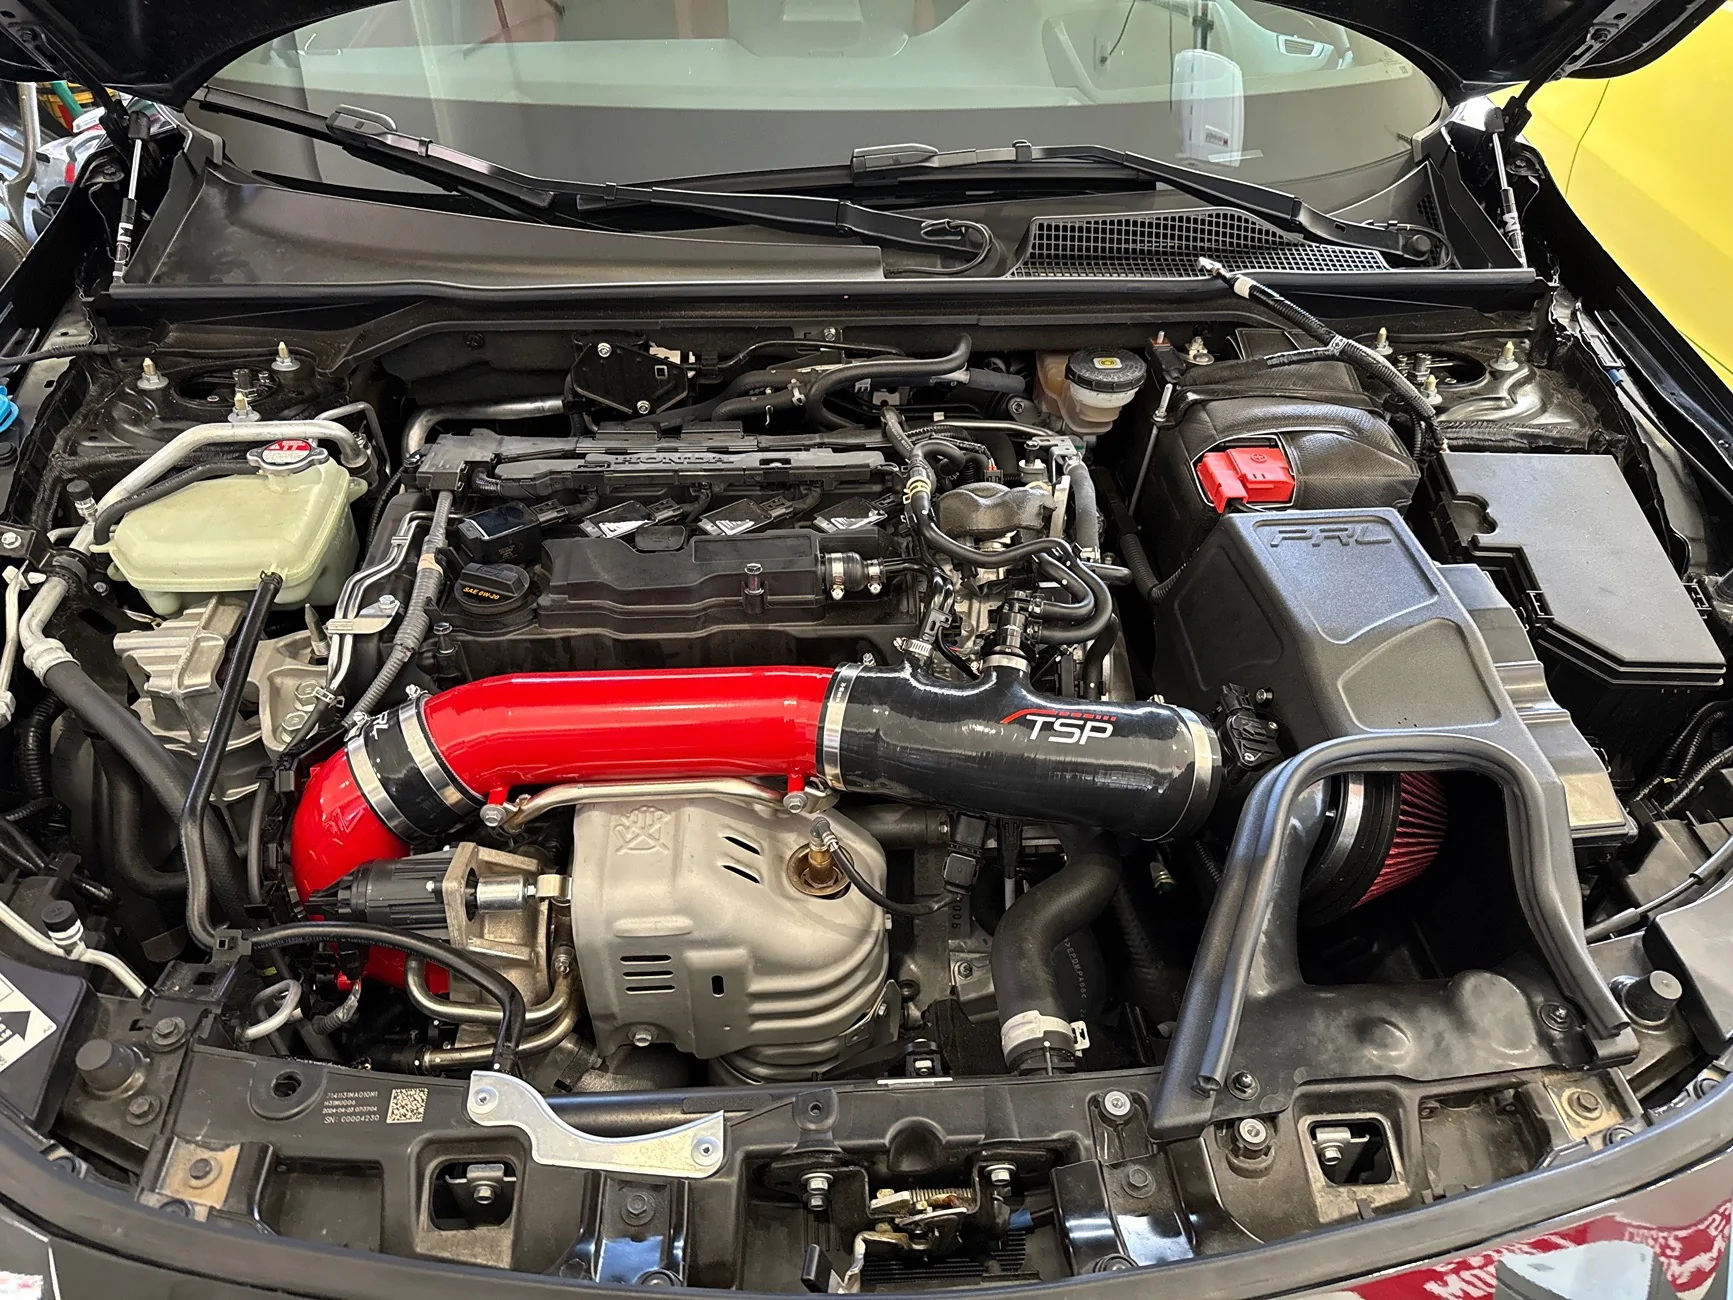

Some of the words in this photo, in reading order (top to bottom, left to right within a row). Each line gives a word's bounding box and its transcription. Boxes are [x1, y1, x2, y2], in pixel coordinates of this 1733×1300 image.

[614, 456, 735, 465] HONDA
[1270, 525, 1393, 548] PRL
[462, 587, 479, 596] SAE
[478, 590, 500, 600] 0W-20
[1026, 714, 1114, 745] TSP
[323, 1116, 339, 1124] SN:
